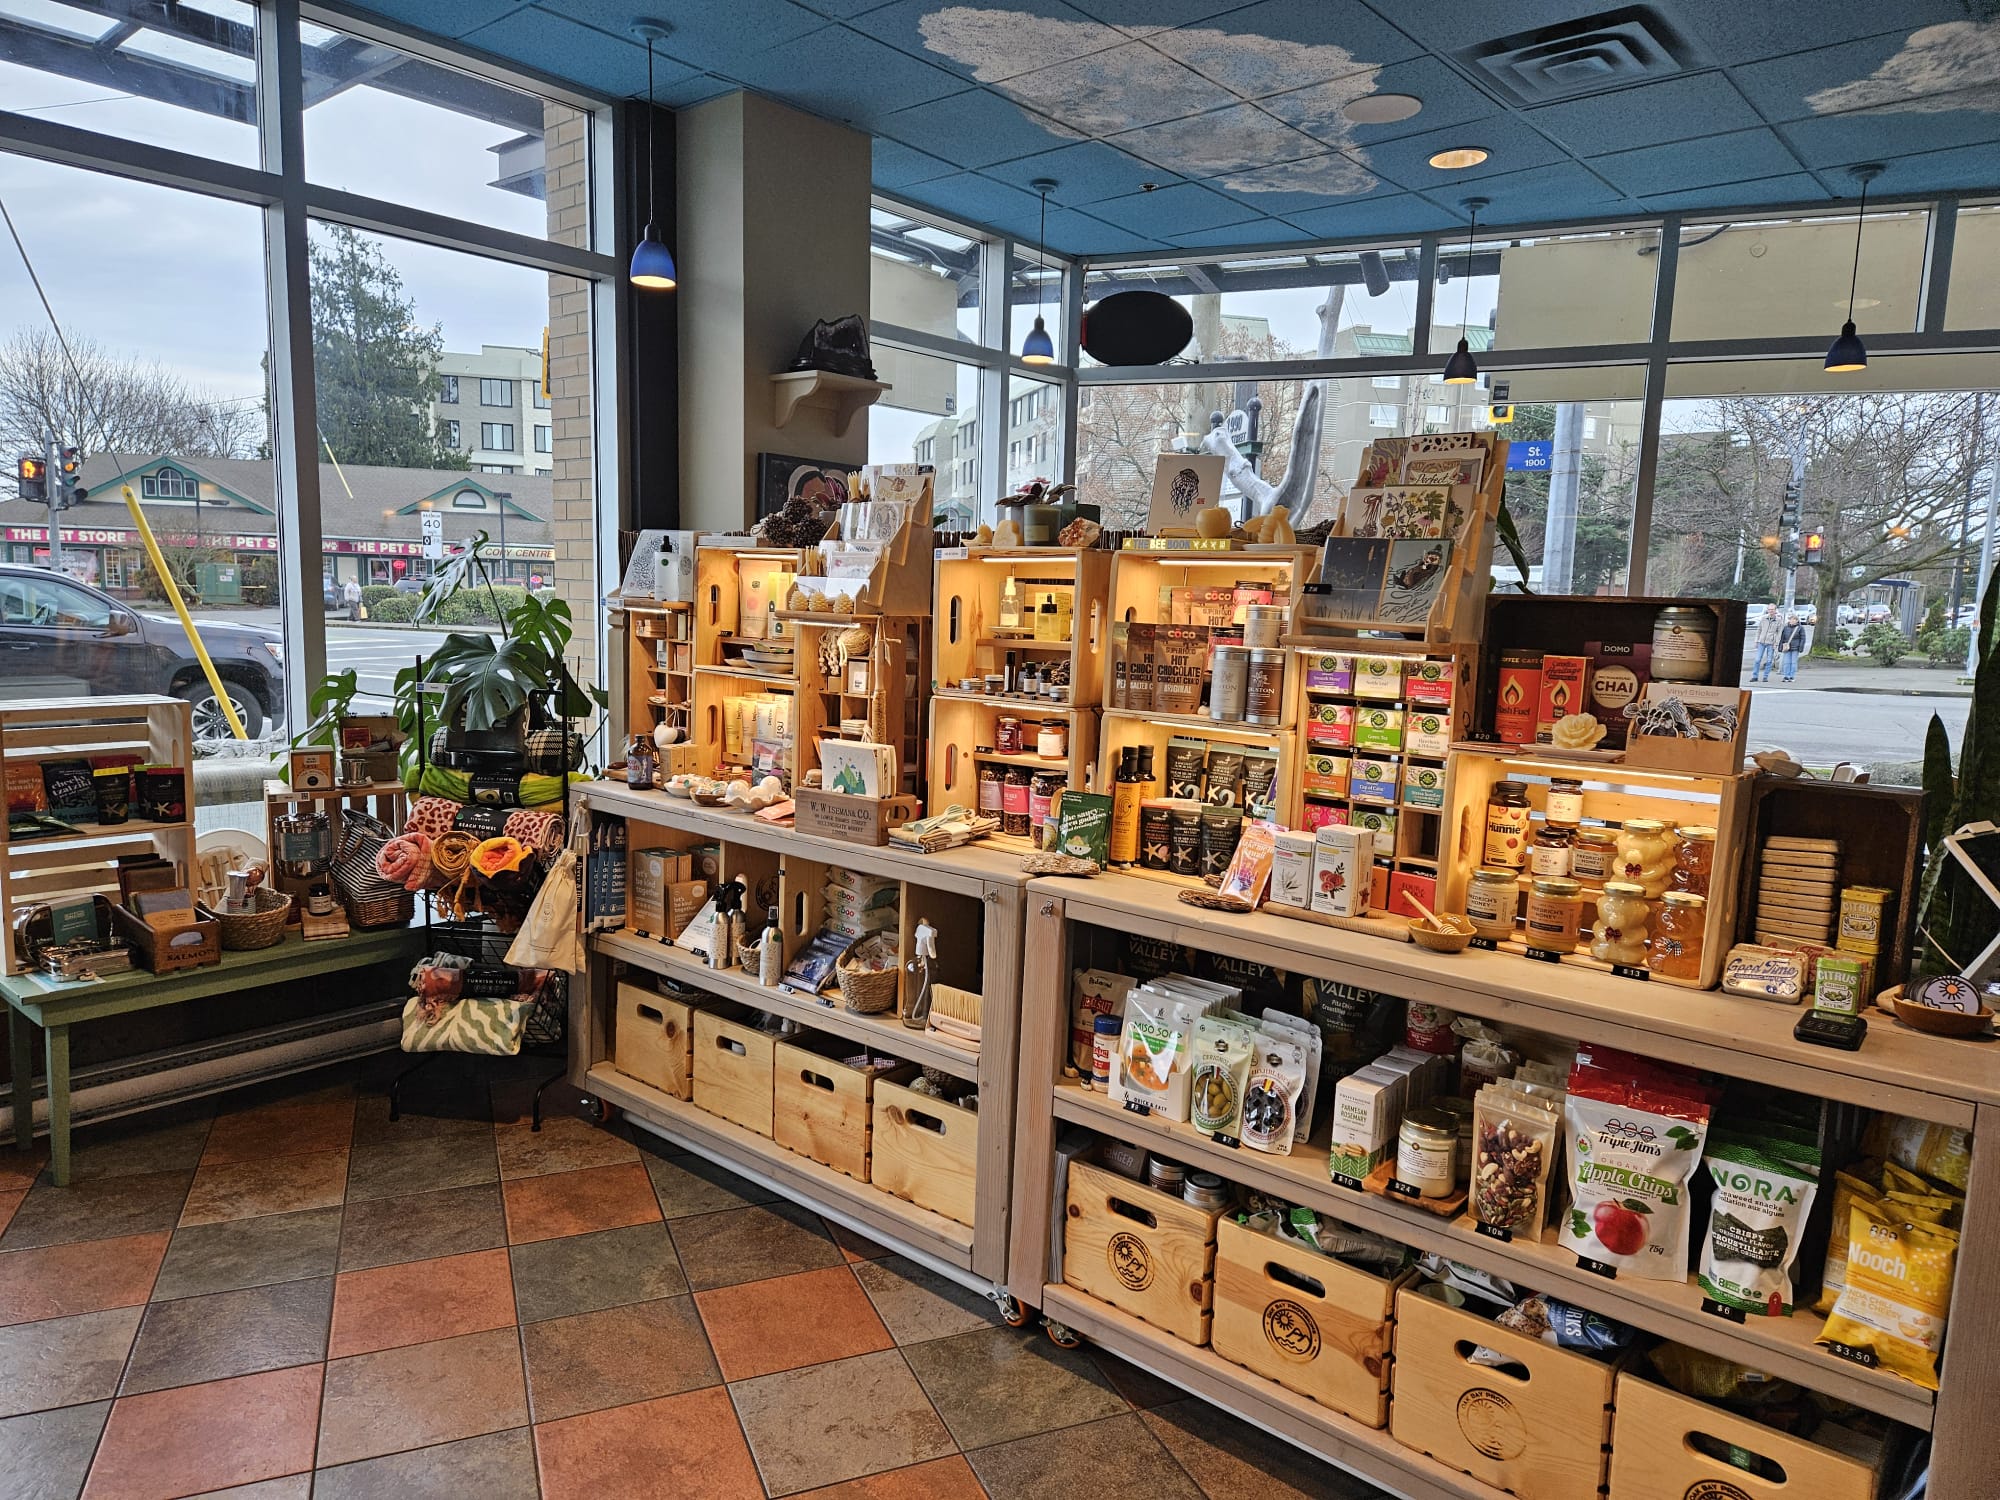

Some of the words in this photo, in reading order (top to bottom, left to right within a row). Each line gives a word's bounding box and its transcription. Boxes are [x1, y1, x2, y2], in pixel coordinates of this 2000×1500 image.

[1528, 446, 1543, 457] St.
[1525, 458, 1546, 467] 1900
[1415, 473, 1449, 485] Perfect
[424, 519, 441, 529] 40
[11, 528, 42, 541] THE
[78, 530, 126, 543] STORE
[236, 537, 264, 549] PET
[349, 542, 375, 553] THE
[380, 543, 405, 554] PET
[408, 544, 450, 555] STE
[1133, 539, 1149, 549] THE
[1150, 538, 1166, 549] BEE
[1168, 539, 1190, 549] BOOK
[485, 548, 511, 558] COY
[515, 549, 553, 559] CENTRE
[1208, 616, 1225, 626] HOT
[1604, 645, 1630, 653] DOMO
[1171, 655, 1189, 666] HOT
[1157, 664, 1201, 678] CHOCOLATE
[1164, 685, 1192, 694] ORIGINAL
[1594, 680, 1634, 694] CHAI
[1666, 688, 1688, 696] Vinyl
[1689, 689, 1721, 697] Sticker
[51, 775, 88, 790] cheeky
[52, 778, 92, 796] tzatziki
[857, 808, 872, 821] CO.
[1077, 807, 1099, 819] saucy
[458, 822, 477, 830] BEACH
[478, 824, 497, 832] TOWEL
[1842, 902, 1880, 915] CITRUS
[1535, 913, 1558, 921] HONEY
[1472, 938, 1487, 946] $24
[1128, 941, 1179, 963] VALLEY
[1528, 949, 1545, 958] $15
[1211, 955, 1267, 977] VALLEY
[1622, 968, 1641, 977] $13
[1727, 958, 1764, 973] Good
[1763, 960, 1799, 978] Time
[1818, 971, 1857, 986] CITRUS
[1319, 980, 1379, 1005] VALLEY
[1133, 1021, 1155, 1034] MISO
[1133, 1097, 1150, 1106] QUICK
[1155, 1103, 1168, 1112] EASY
[1341, 1103, 1368, 1116] PARMESAN
[1340, 1110, 1367, 1123] ROSEMARY
[1629, 1140, 1662, 1157] Jim's
[1104, 1147, 1134, 1168] GINGER
[1601, 1157, 1653, 1174] ORGANIC
[1583, 1163, 1625, 1186] Apple
[1628, 1171, 1673, 1198] Chips
[1711, 1166, 1798, 1206] NORA
[1394, 1182, 1412, 1194] $24
[1748, 1204, 1761, 1212] aux
[1762, 1207, 1785, 1219] algues
[1754, 1199, 1783, 1212] snacks
[1719, 1228, 1750, 1244] ORIGINAL
[1729, 1226, 1766, 1242] CRISPY
[1648, 1244, 1665, 1256] 75g
[1712, 1231, 1780, 1257] CROUSTILLANTE
[1715, 1241, 1740, 1253] SAVEUR
[1591, 1262, 1604, 1271] $7
[1717, 1304, 1730, 1315] $6
[1834, 1344, 1871, 1363] $3.50
[1471, 1391, 1483, 1399] BAY
